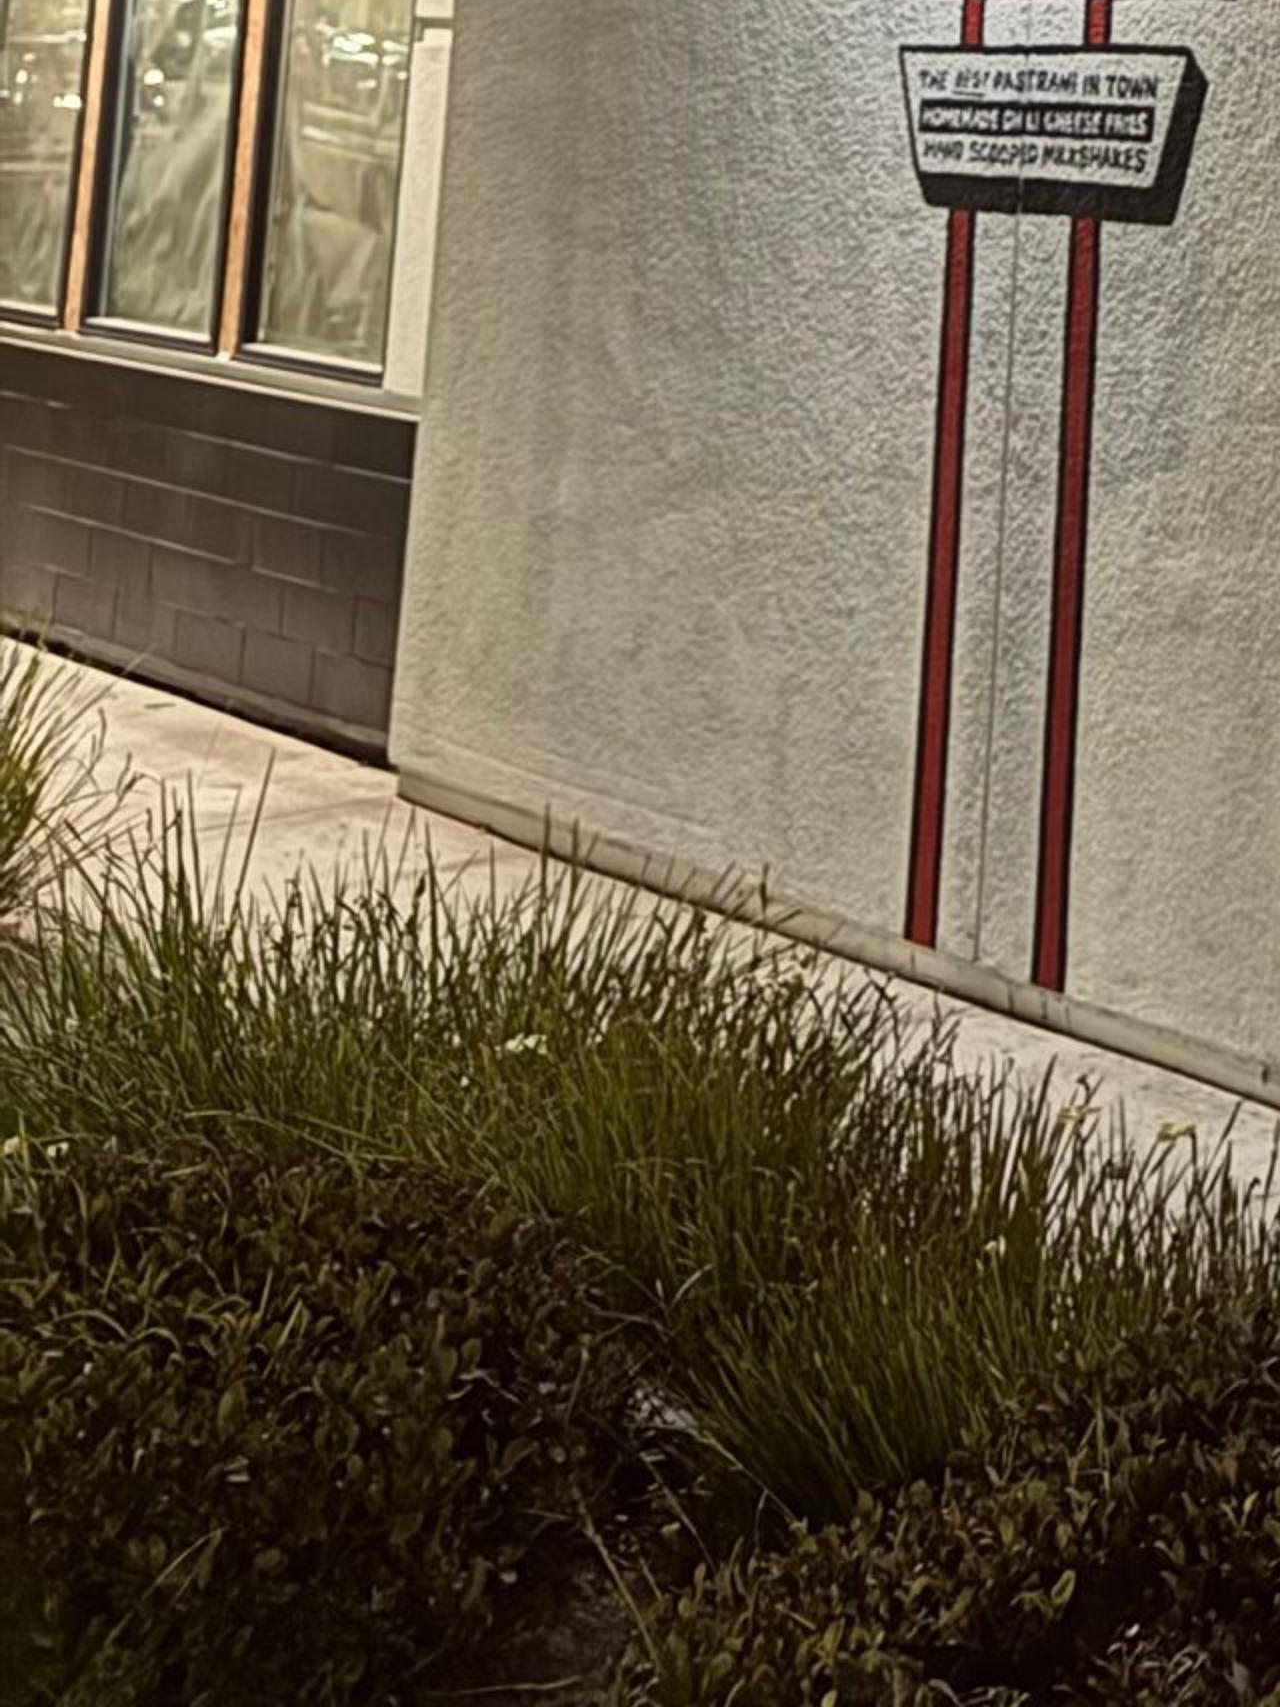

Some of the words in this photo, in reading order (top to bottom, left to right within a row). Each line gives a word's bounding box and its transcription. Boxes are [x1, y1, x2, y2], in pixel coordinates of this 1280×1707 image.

[919, 69, 948, 92] THE
[993, 69, 1078, 95] PASTRAMI
[1081, 74, 1101, 97] IN
[1105, 74, 1158, 99] TOWN
[1043, 110, 1103, 136] CHEESE
[1104, 112, 1149, 137] FRIES
[922, 140, 965, 161] HAND
[966, 140, 1040, 166] SCOOPED
[1041, 144, 1148, 174] MILKSHAKES
